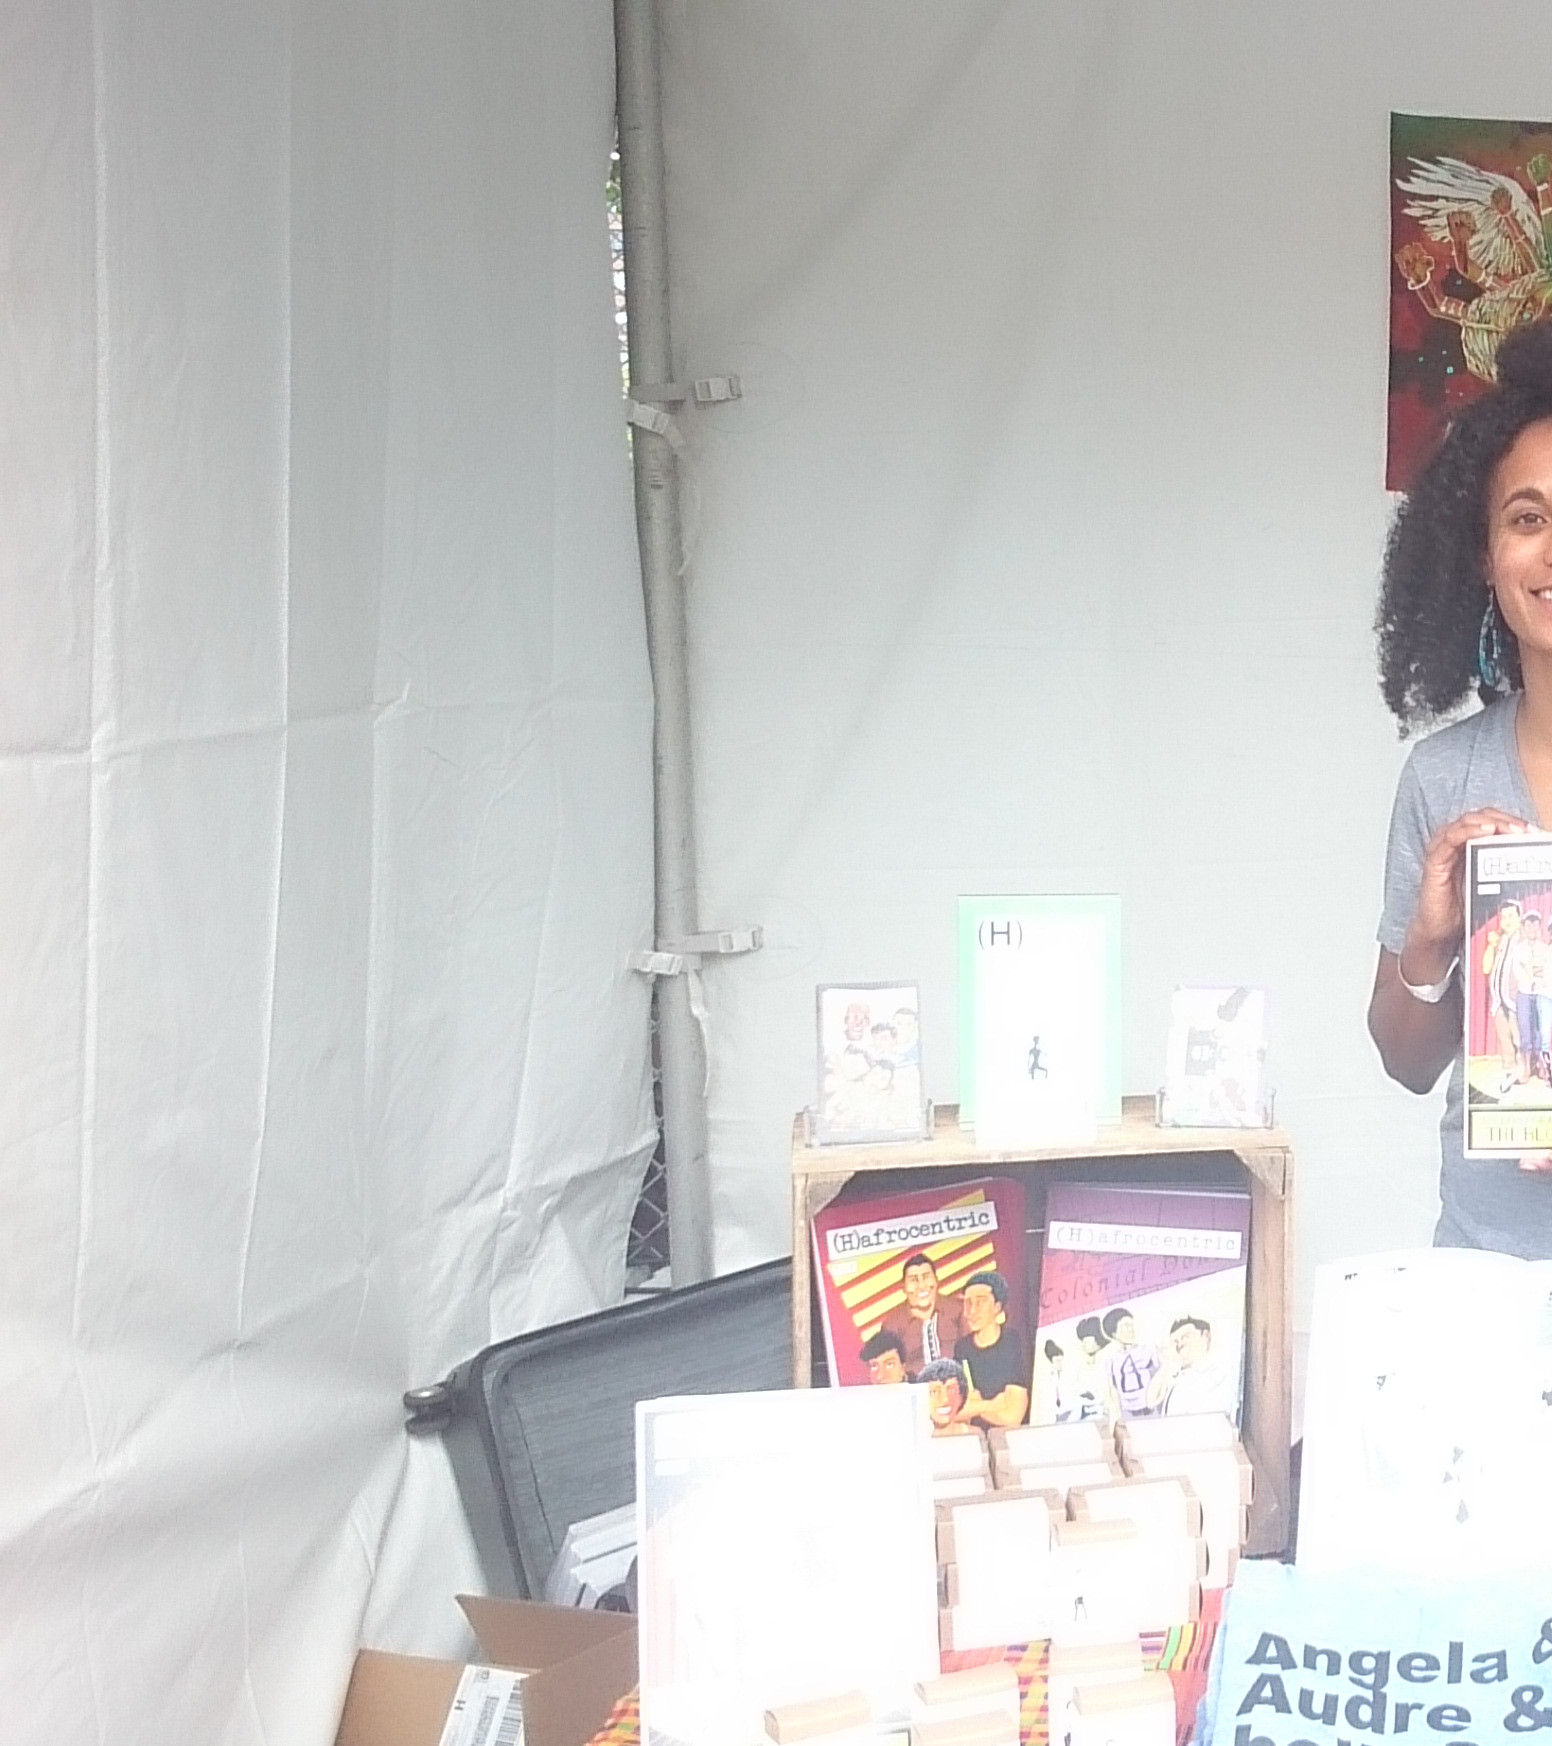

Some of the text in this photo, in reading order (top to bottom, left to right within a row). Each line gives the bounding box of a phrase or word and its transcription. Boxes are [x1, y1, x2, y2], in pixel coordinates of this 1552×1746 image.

[978, 920, 1023, 950] (H)
[833, 1210, 990, 1253] (H)afrocentric
[1056, 1226, 1235, 1251] (H)afrocentric
[1244, 1632, 1509, 1691] Angela
[1236, 1672, 1472, 1735] Audre
